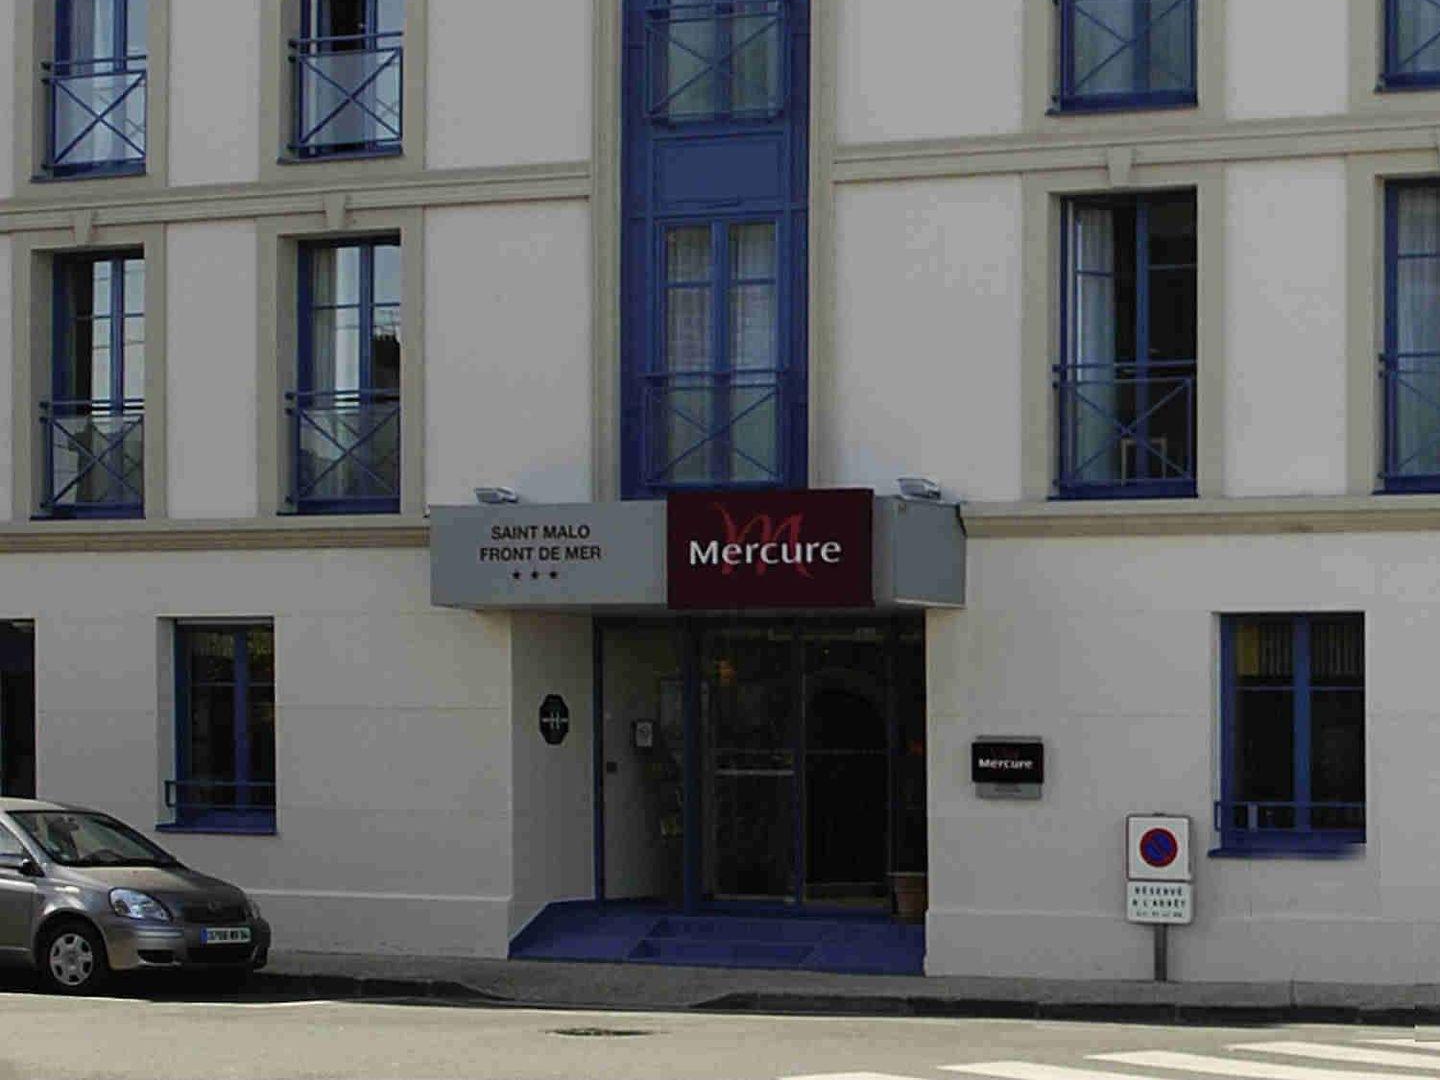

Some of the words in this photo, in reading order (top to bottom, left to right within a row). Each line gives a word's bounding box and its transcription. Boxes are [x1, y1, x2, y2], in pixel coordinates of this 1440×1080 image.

[491, 525, 538, 540] SAINT
[543, 524, 590, 539] MALO
[480, 546, 535, 561] FRONT
[538, 546, 561, 560] DE
[564, 544, 602, 560] MER
[688, 539, 843, 566] Mercure
[978, 758, 1033, 769] Mercure
